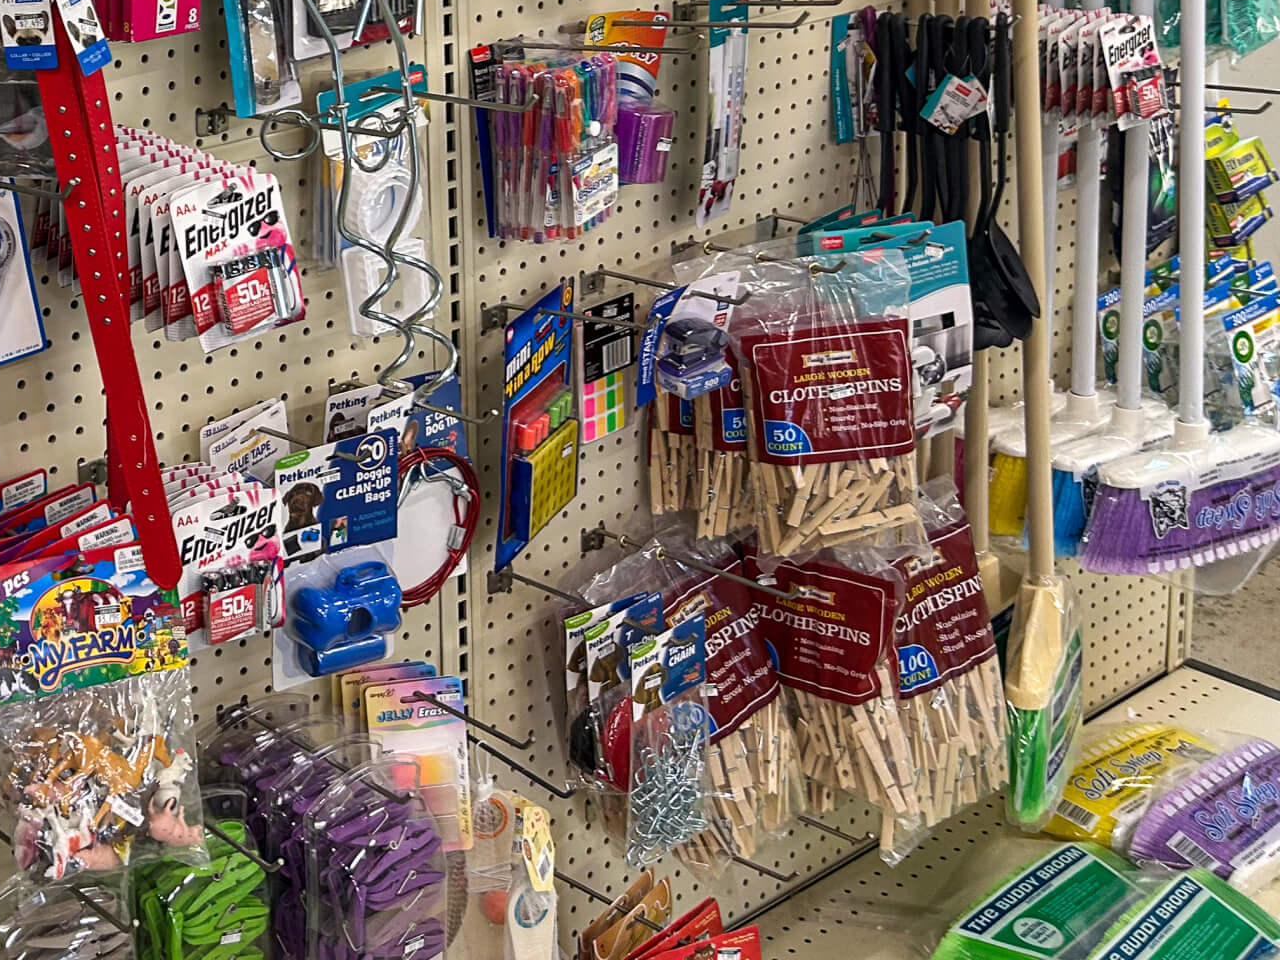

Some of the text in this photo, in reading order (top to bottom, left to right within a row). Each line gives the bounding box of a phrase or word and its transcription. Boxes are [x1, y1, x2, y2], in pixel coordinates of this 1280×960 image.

[188, 7, 198, 24] 8
[1108, 23, 1151, 68] Energizer
[184, 185, 275, 261] Energizer
[204, 241, 228, 261] MAX
[238, 280, 269, 304] 50%
[193, 293, 210, 313] 12
[1231, 311, 1247, 327] 300
[793, 367, 871, 384] LARGE WOODEN
[328, 395, 368, 412] Petking
[369, 406, 403, 426] Petking
[424, 421, 445, 437] DOG
[773, 428, 797, 442] 50
[767, 441, 804, 452] COUNT
[226, 440, 272, 474] GLUE TAPE
[278, 466, 323, 486] Petking
[355, 466, 392, 482] Doggie
[335, 477, 392, 501] CLEAN-UP
[364, 489, 392, 504] Bags
[180, 499, 278, 566] Energizer
[197, 552, 223, 569] MAX
[1, 569, 31, 595] pcs
[222, 592, 254, 616] 50%
[70, 623, 136, 658] FARM
[668, 644, 697, 668] CHAIN
[899, 650, 929, 671] 100
[375, 707, 414, 723] JELLY
[1073, 747, 1163, 802] Soft Sweep
[1193, 777, 1280, 843] Soft Sweep
[966, 906, 1000, 933] THE
[997, 879, 1041, 911] BUDDY
[1037, 848, 1085, 882] BROOM
[1119, 914, 1161, 959] BUDDY
[1155, 880, 1200, 919] BROOM
